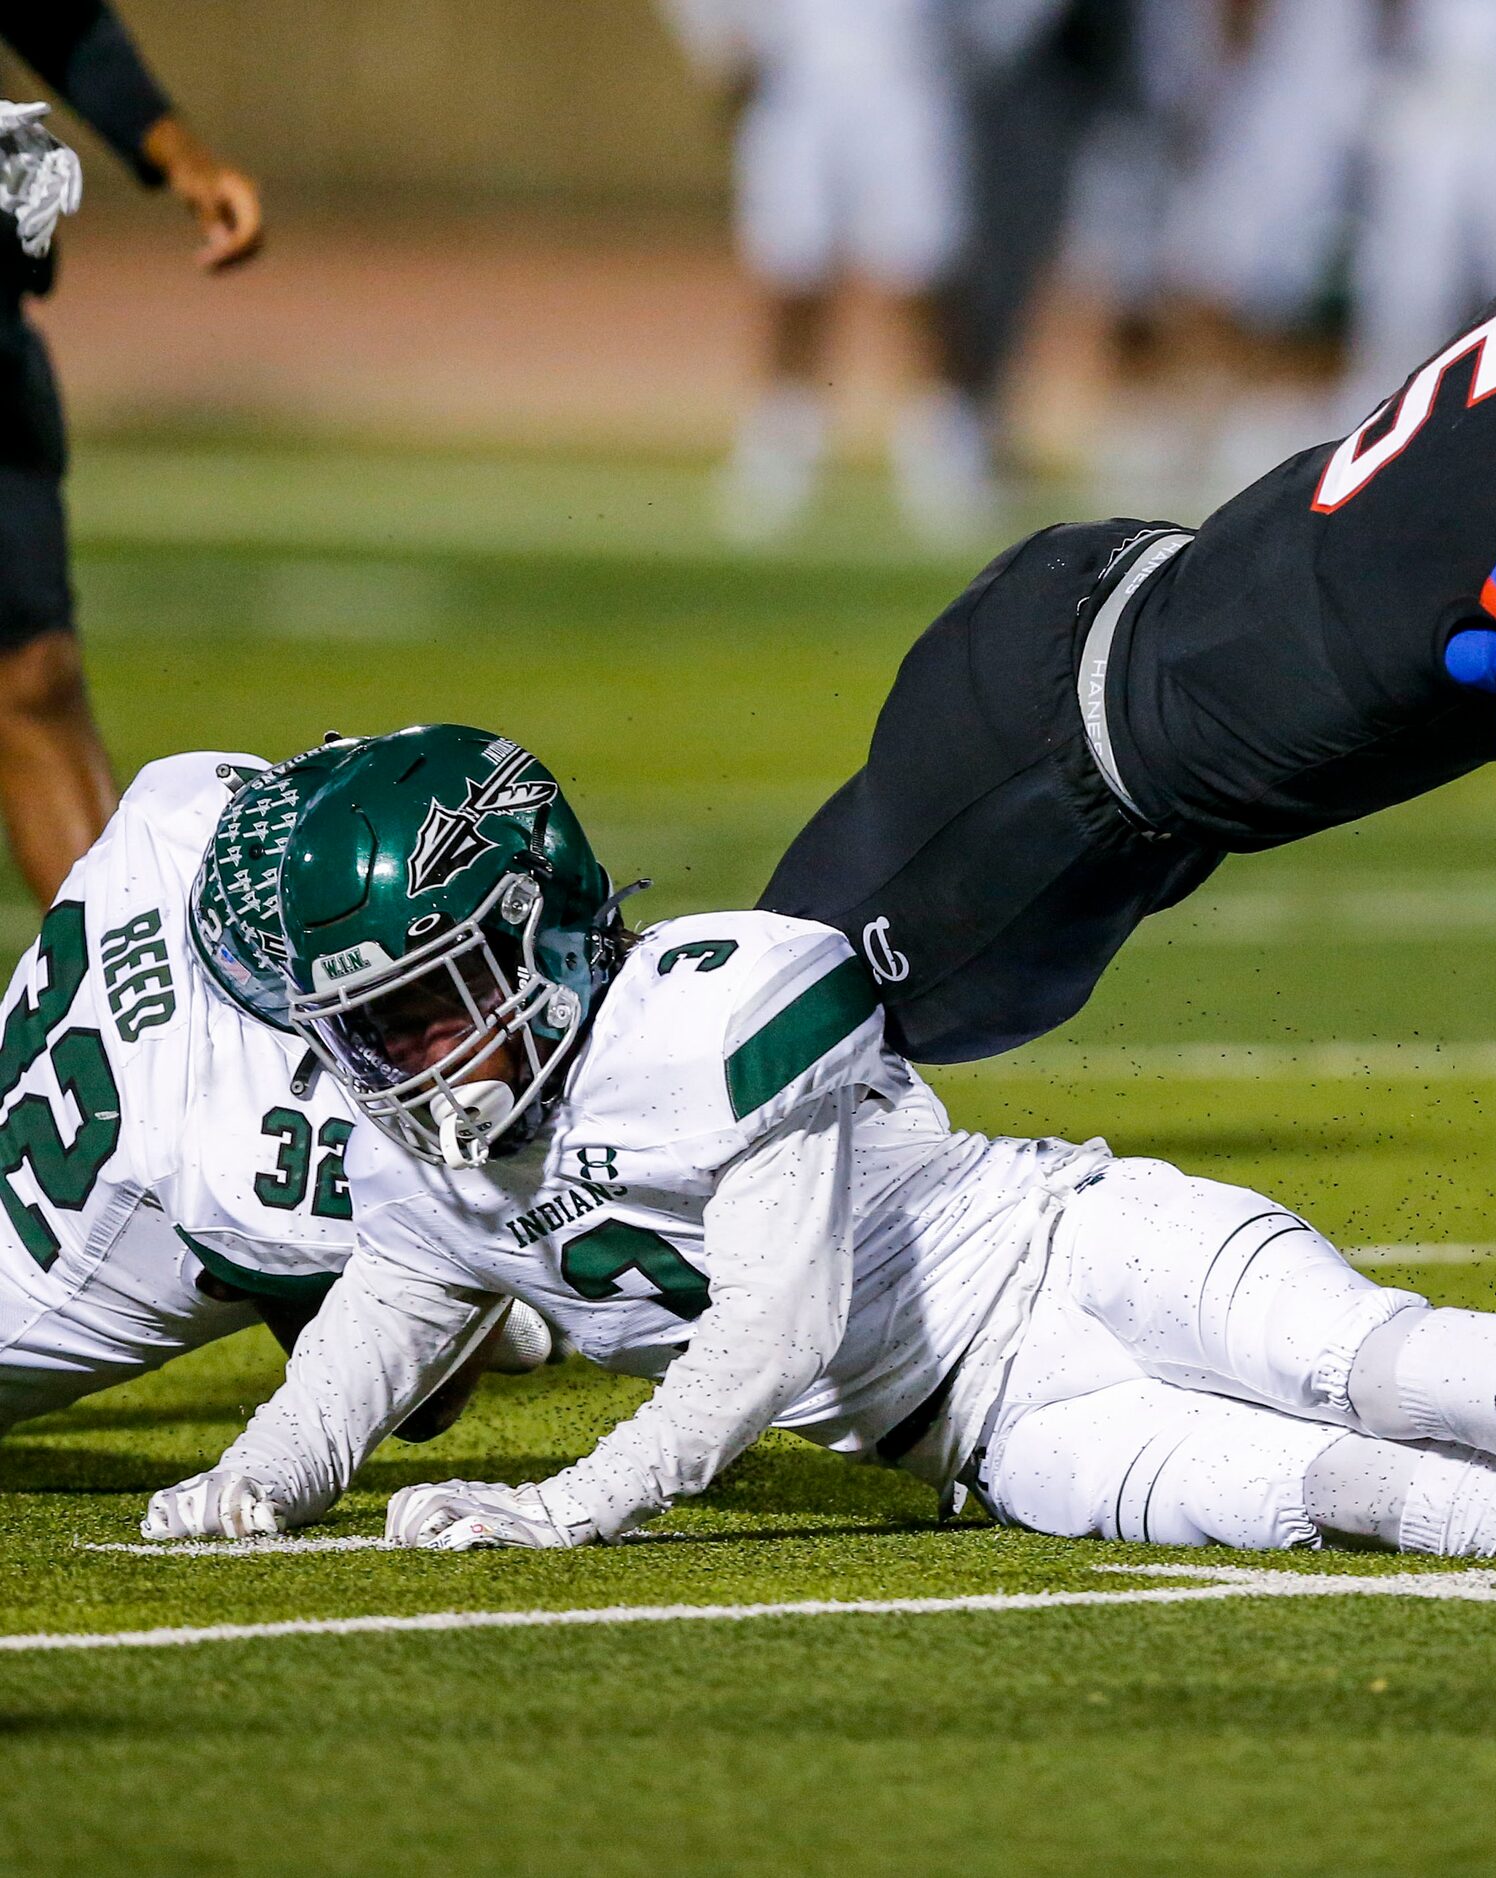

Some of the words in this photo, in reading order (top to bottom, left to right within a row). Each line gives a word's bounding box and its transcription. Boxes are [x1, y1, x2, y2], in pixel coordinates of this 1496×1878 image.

[101, 908, 176, 1043] REED
[320, 948, 372, 981] W.I.N.
[657, 940, 739, 977] 3
[254, 1106, 357, 1221] 32
